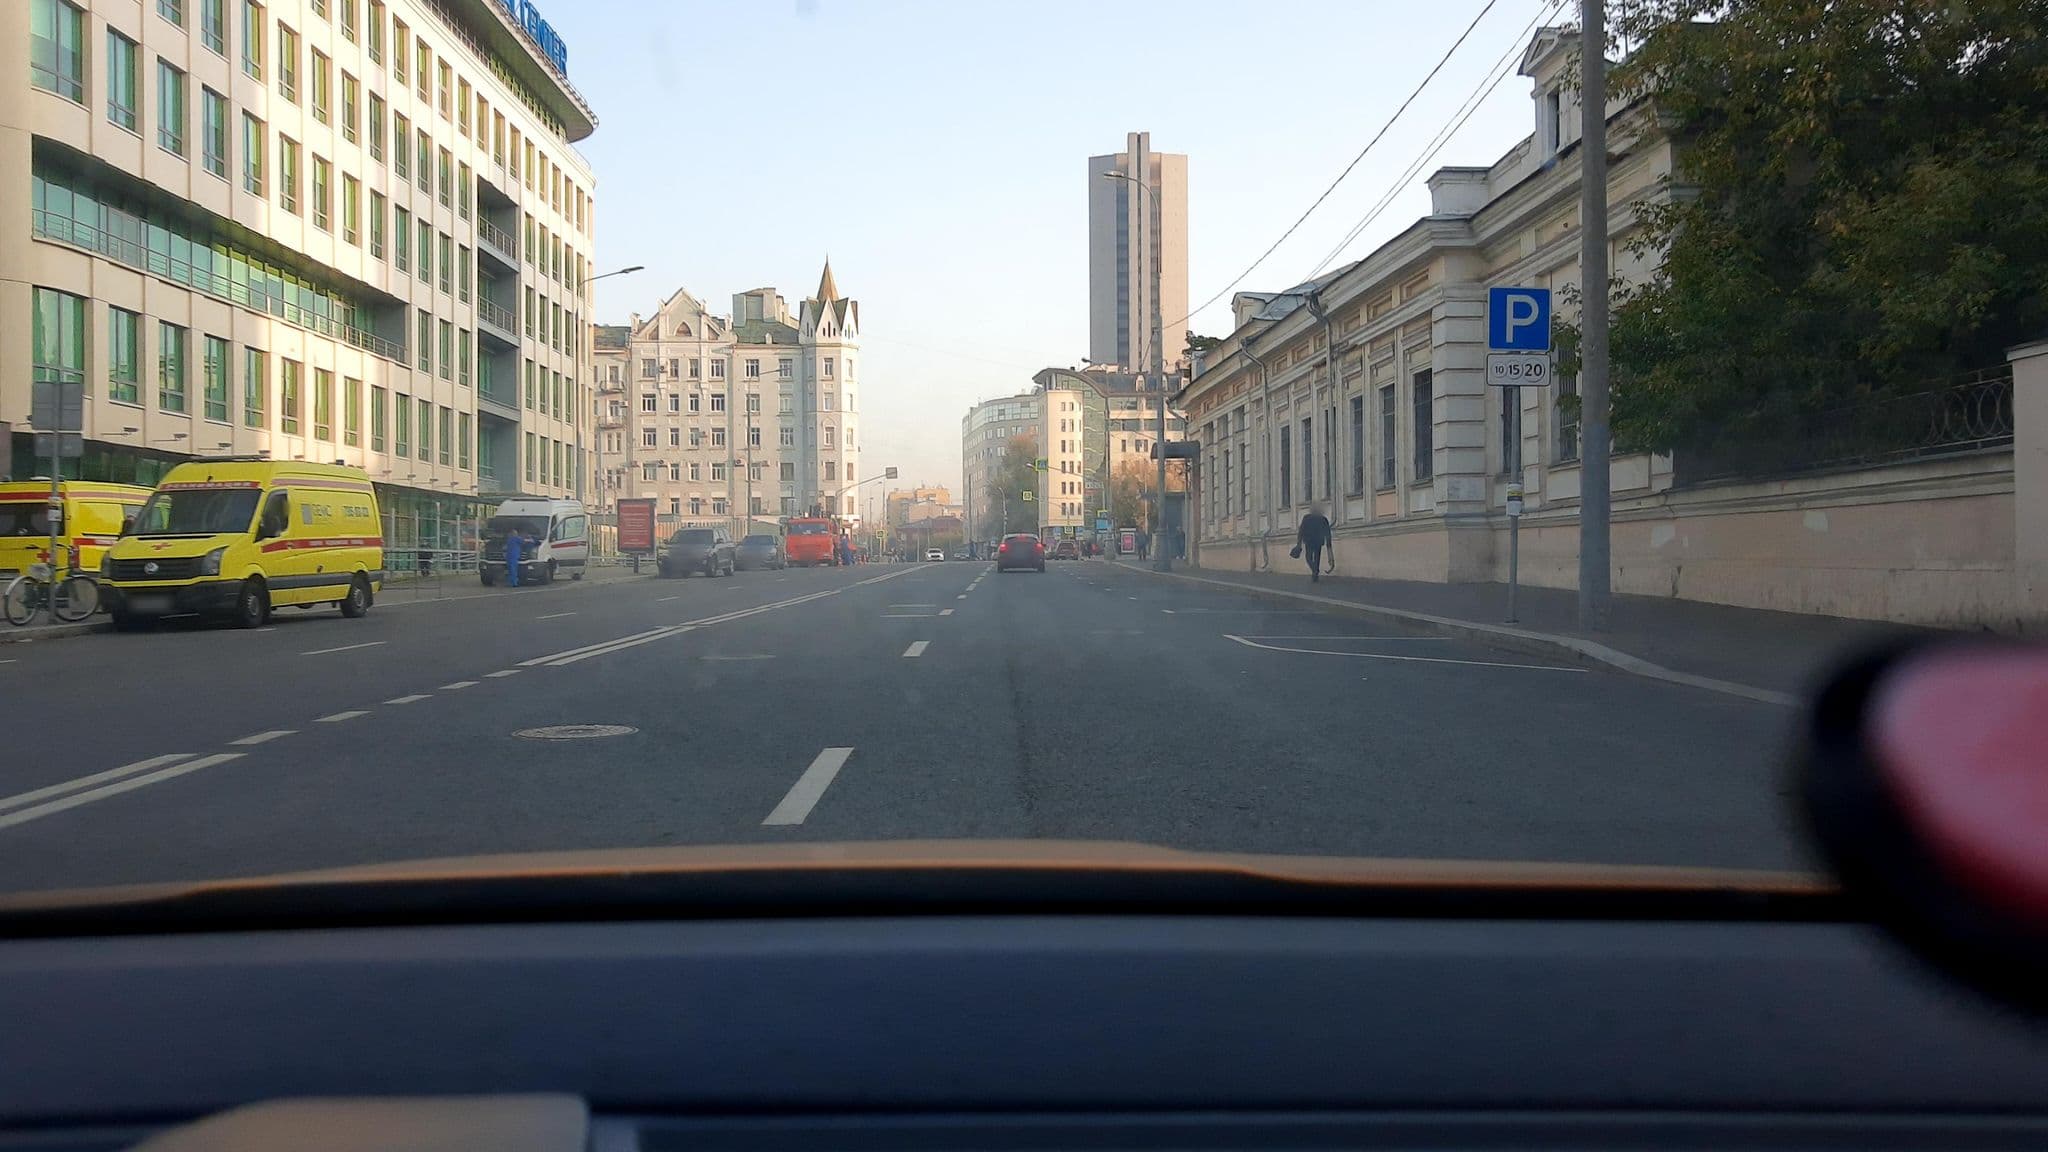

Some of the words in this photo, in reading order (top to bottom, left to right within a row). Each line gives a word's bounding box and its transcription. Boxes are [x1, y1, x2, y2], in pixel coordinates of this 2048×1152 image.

[1505, 294, 1539, 344] P
[1495, 365, 1504, 374] 10
[1508, 364, 1520, 376] 15
[1524, 363, 1543, 377] 20
